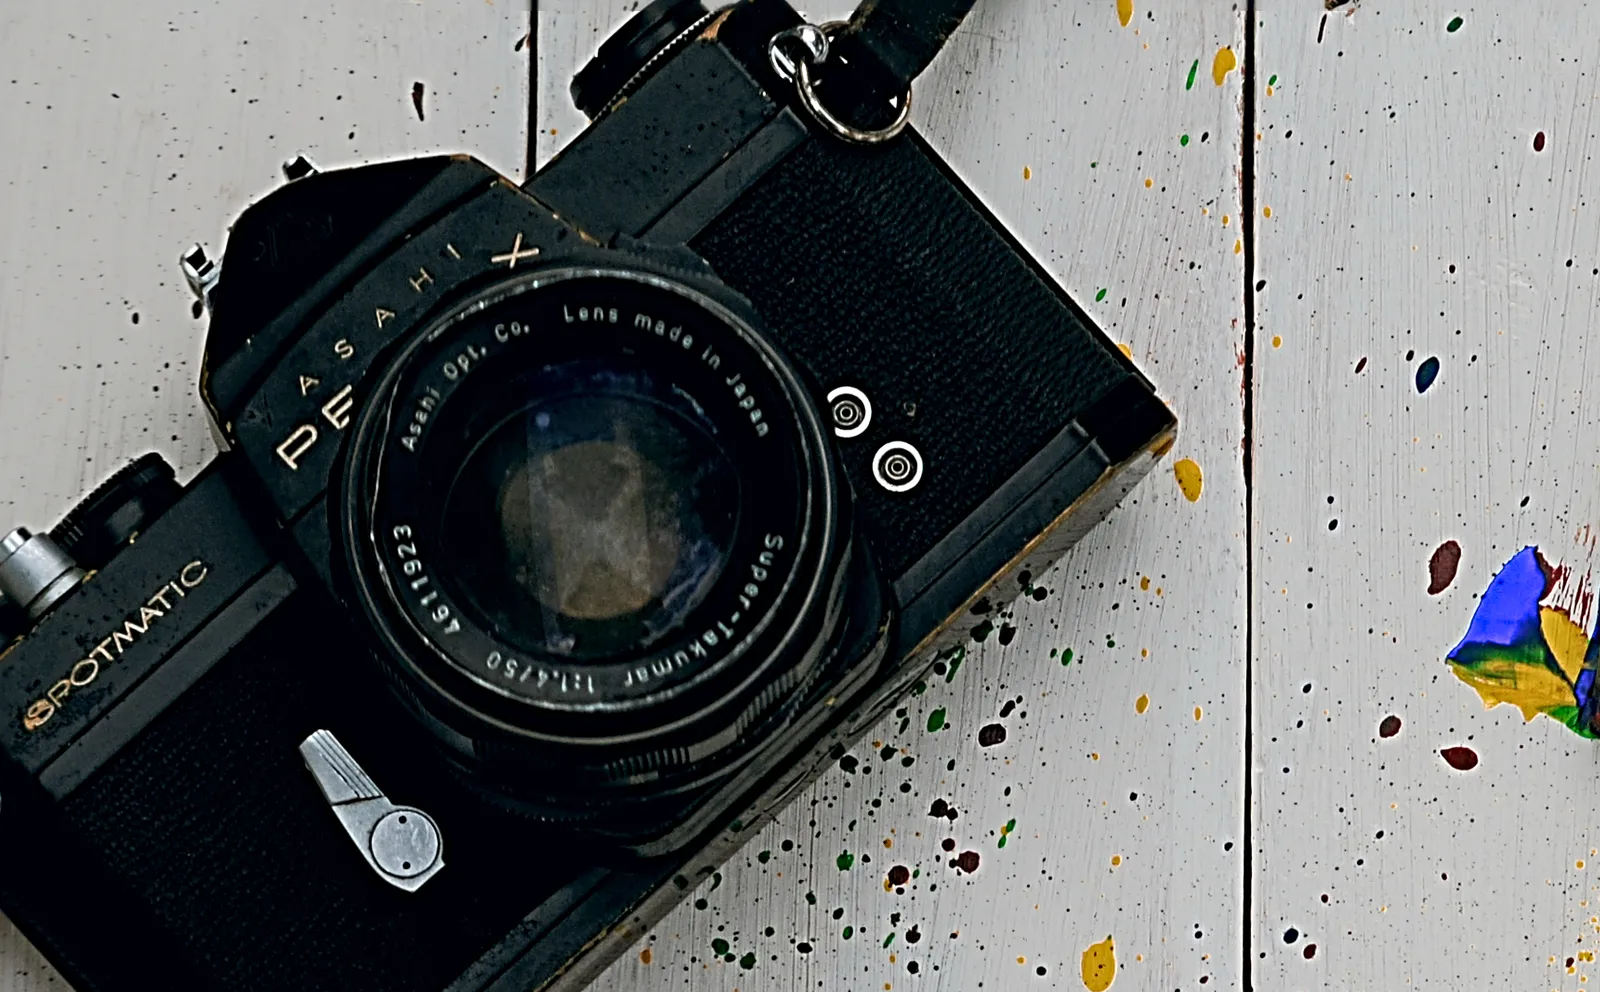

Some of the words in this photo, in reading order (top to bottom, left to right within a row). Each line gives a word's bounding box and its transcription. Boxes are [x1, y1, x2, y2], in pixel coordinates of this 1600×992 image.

[299, 243, 462, 396] ASAHI
[401, 385, 441, 452] Asahi
[443, 344, 487, 381] Opt.
[494, 320, 530, 343] Co.
[563, 304, 618, 323] Lens
[634, 312, 694, 349] made
[701, 345, 721, 370] in
[726, 373, 769, 437] Japan
[23, 560, 208, 731] SPOTMATIC
[393, 524, 461, 634] 4611923
[624, 532, 784, 688] Super-Takumar
